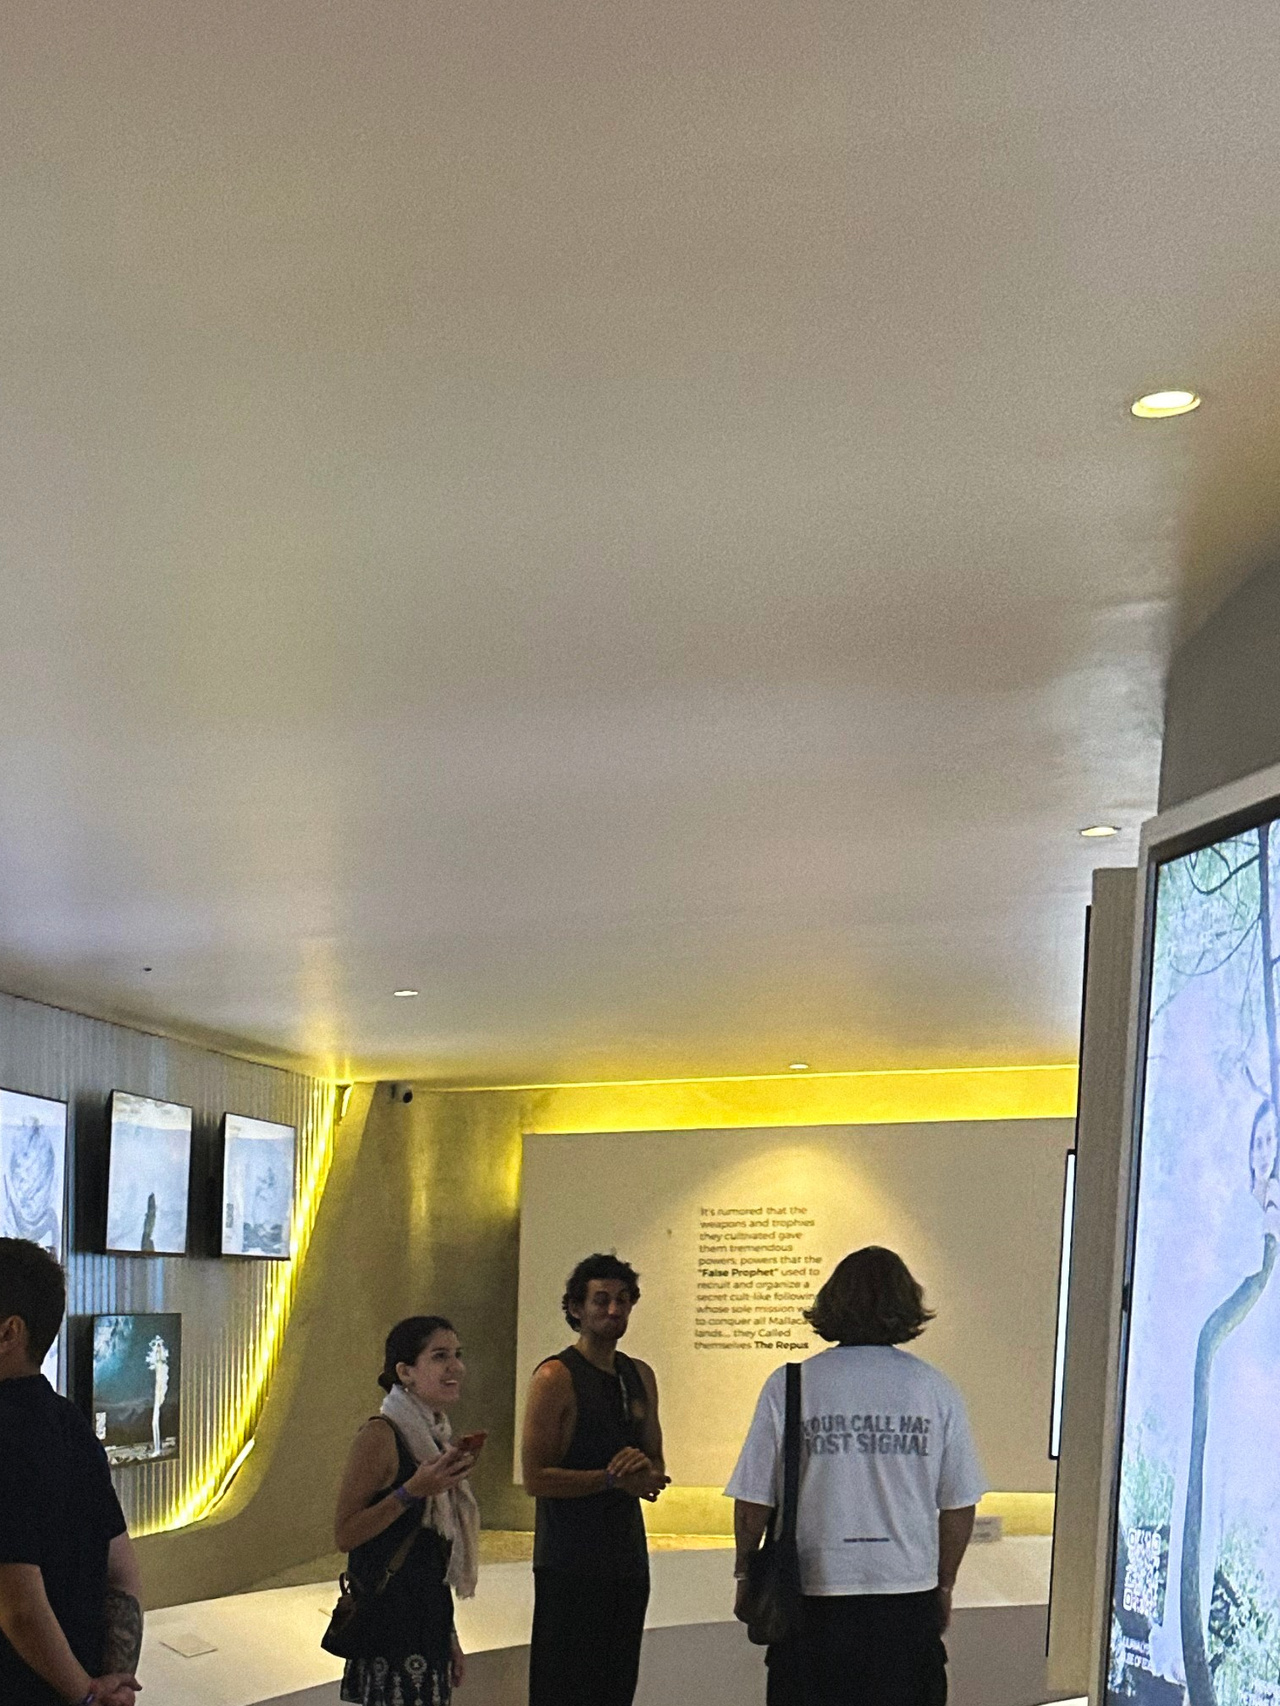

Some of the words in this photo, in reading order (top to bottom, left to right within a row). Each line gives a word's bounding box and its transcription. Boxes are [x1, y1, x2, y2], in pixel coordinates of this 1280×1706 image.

[701, 1207, 715, 1216] It's
[717, 1207, 763, 1216] rumored
[766, 1207, 787, 1215] that
[789, 1206, 808, 1215] the
[700, 1220, 747, 1230] weapons
[749, 1219, 769, 1228] and
[772, 1219, 815, 1228] trophies
[699, 1232, 722, 1242] they
[724, 1231, 776, 1241] cultivated
[778, 1232, 803, 1241] gave
[699, 1244, 727, 1253] them
[729, 1244, 793, 1252] tremendous
[740, 1256, 778, 1266] powers
[780, 1256, 801, 1264] that
[804, 1256, 822, 1264] the
[698, 1268, 729, 1277] "False
[731, 1268, 778, 1278] Prophet"
[781, 1268, 806, 1276] used
[809, 1268, 820, 1276] to
[697, 1281, 730, 1289] recruit
[733, 1281, 753, 1289] and
[756, 1281, 801, 1290] organize
[697, 1293, 728, 1301] secret
[774, 1292, 815, 1301] followin
[696, 1305, 729, 1313] whose
[731, 1305, 752, 1313] sole
[754, 1305, 795, 1313] mission
[695, 1317, 706, 1326] to
[708, 1317, 751, 1327] conquer
[753, 1317, 766, 1325] all
[733, 1329, 756, 1339] they
[758, 1329, 791, 1338] Called
[694, 1341, 752, 1350] themselves
[754, 1341, 773, 1349] The
[776, 1341, 809, 1351] Repus
[851, 1415, 895, 1433] CALL
[856, 1434, 929, 1456] SIGNAL
